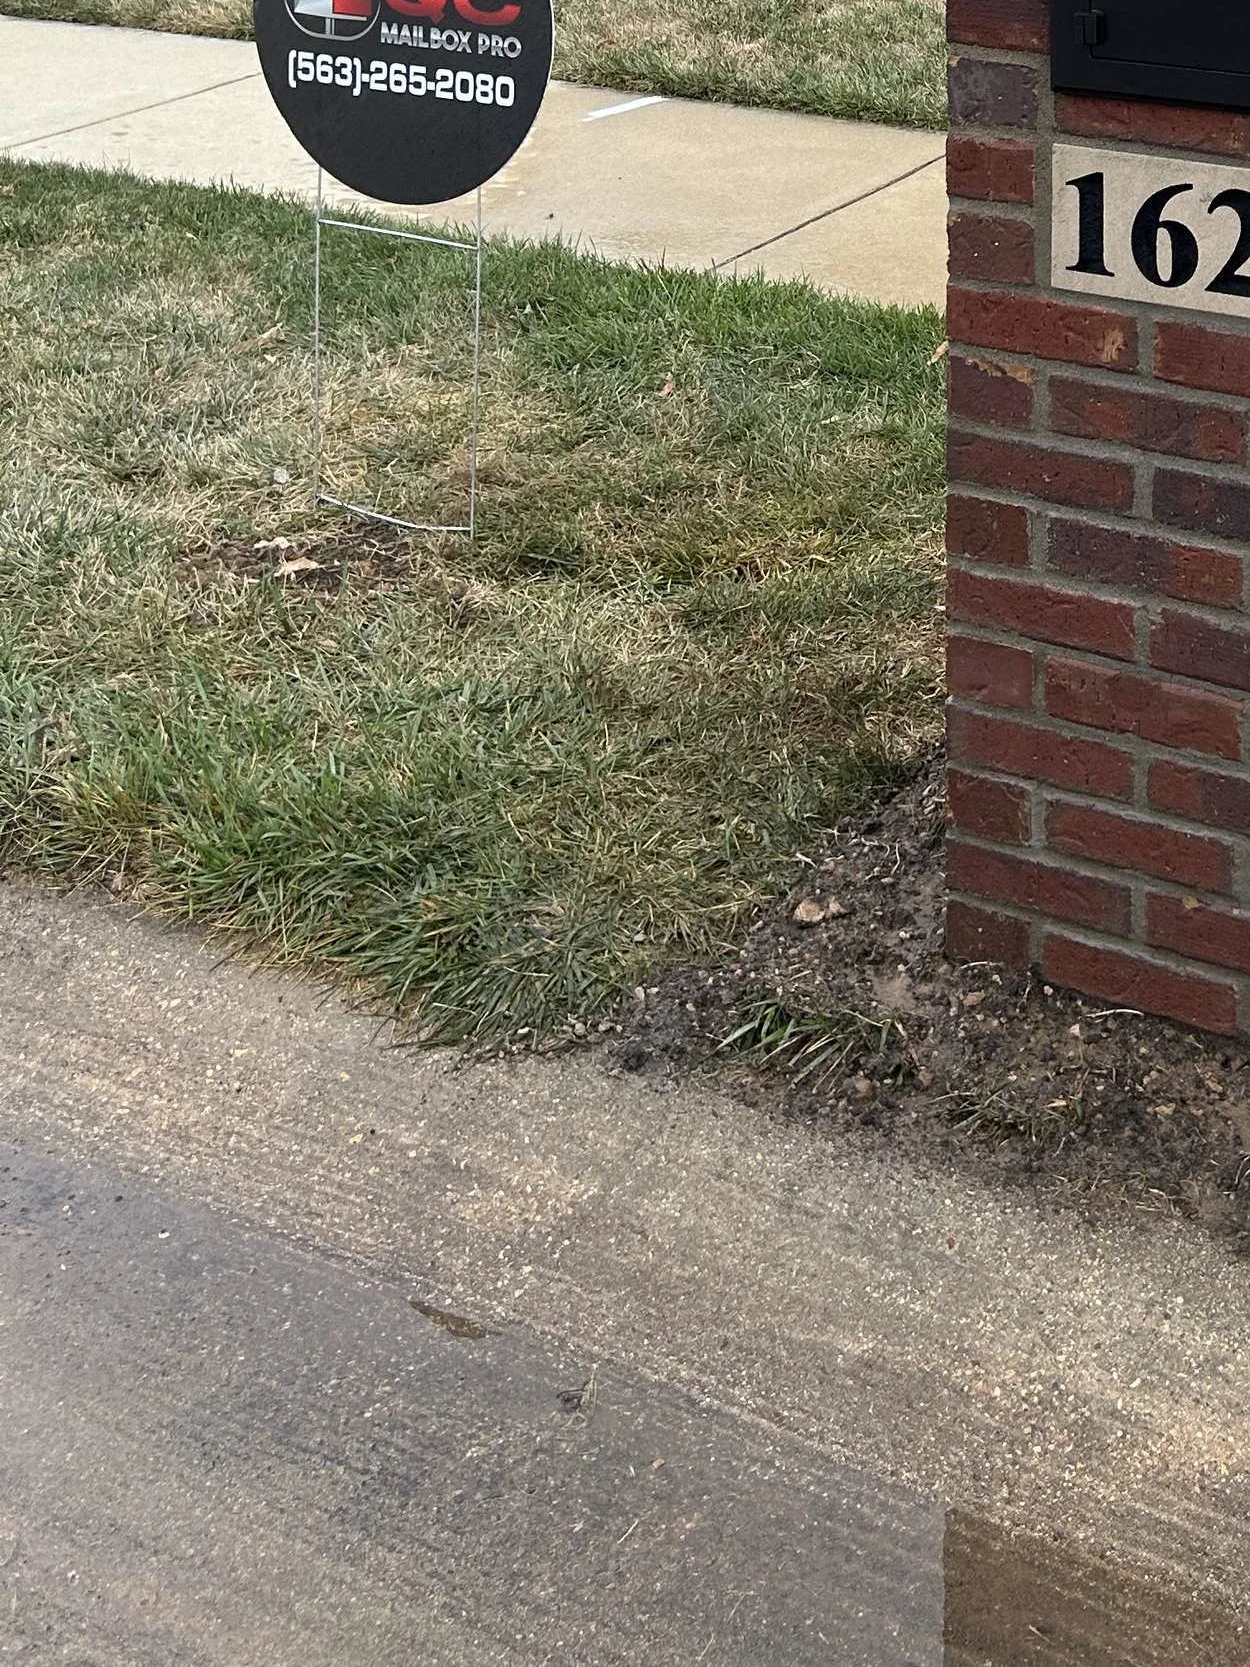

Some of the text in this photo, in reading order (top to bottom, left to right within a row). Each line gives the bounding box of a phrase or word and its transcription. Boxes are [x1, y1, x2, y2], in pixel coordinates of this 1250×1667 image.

[380, 21, 522, 58] MAILBOX PRO
[288, 49, 516, 107] (563)-265-2080
